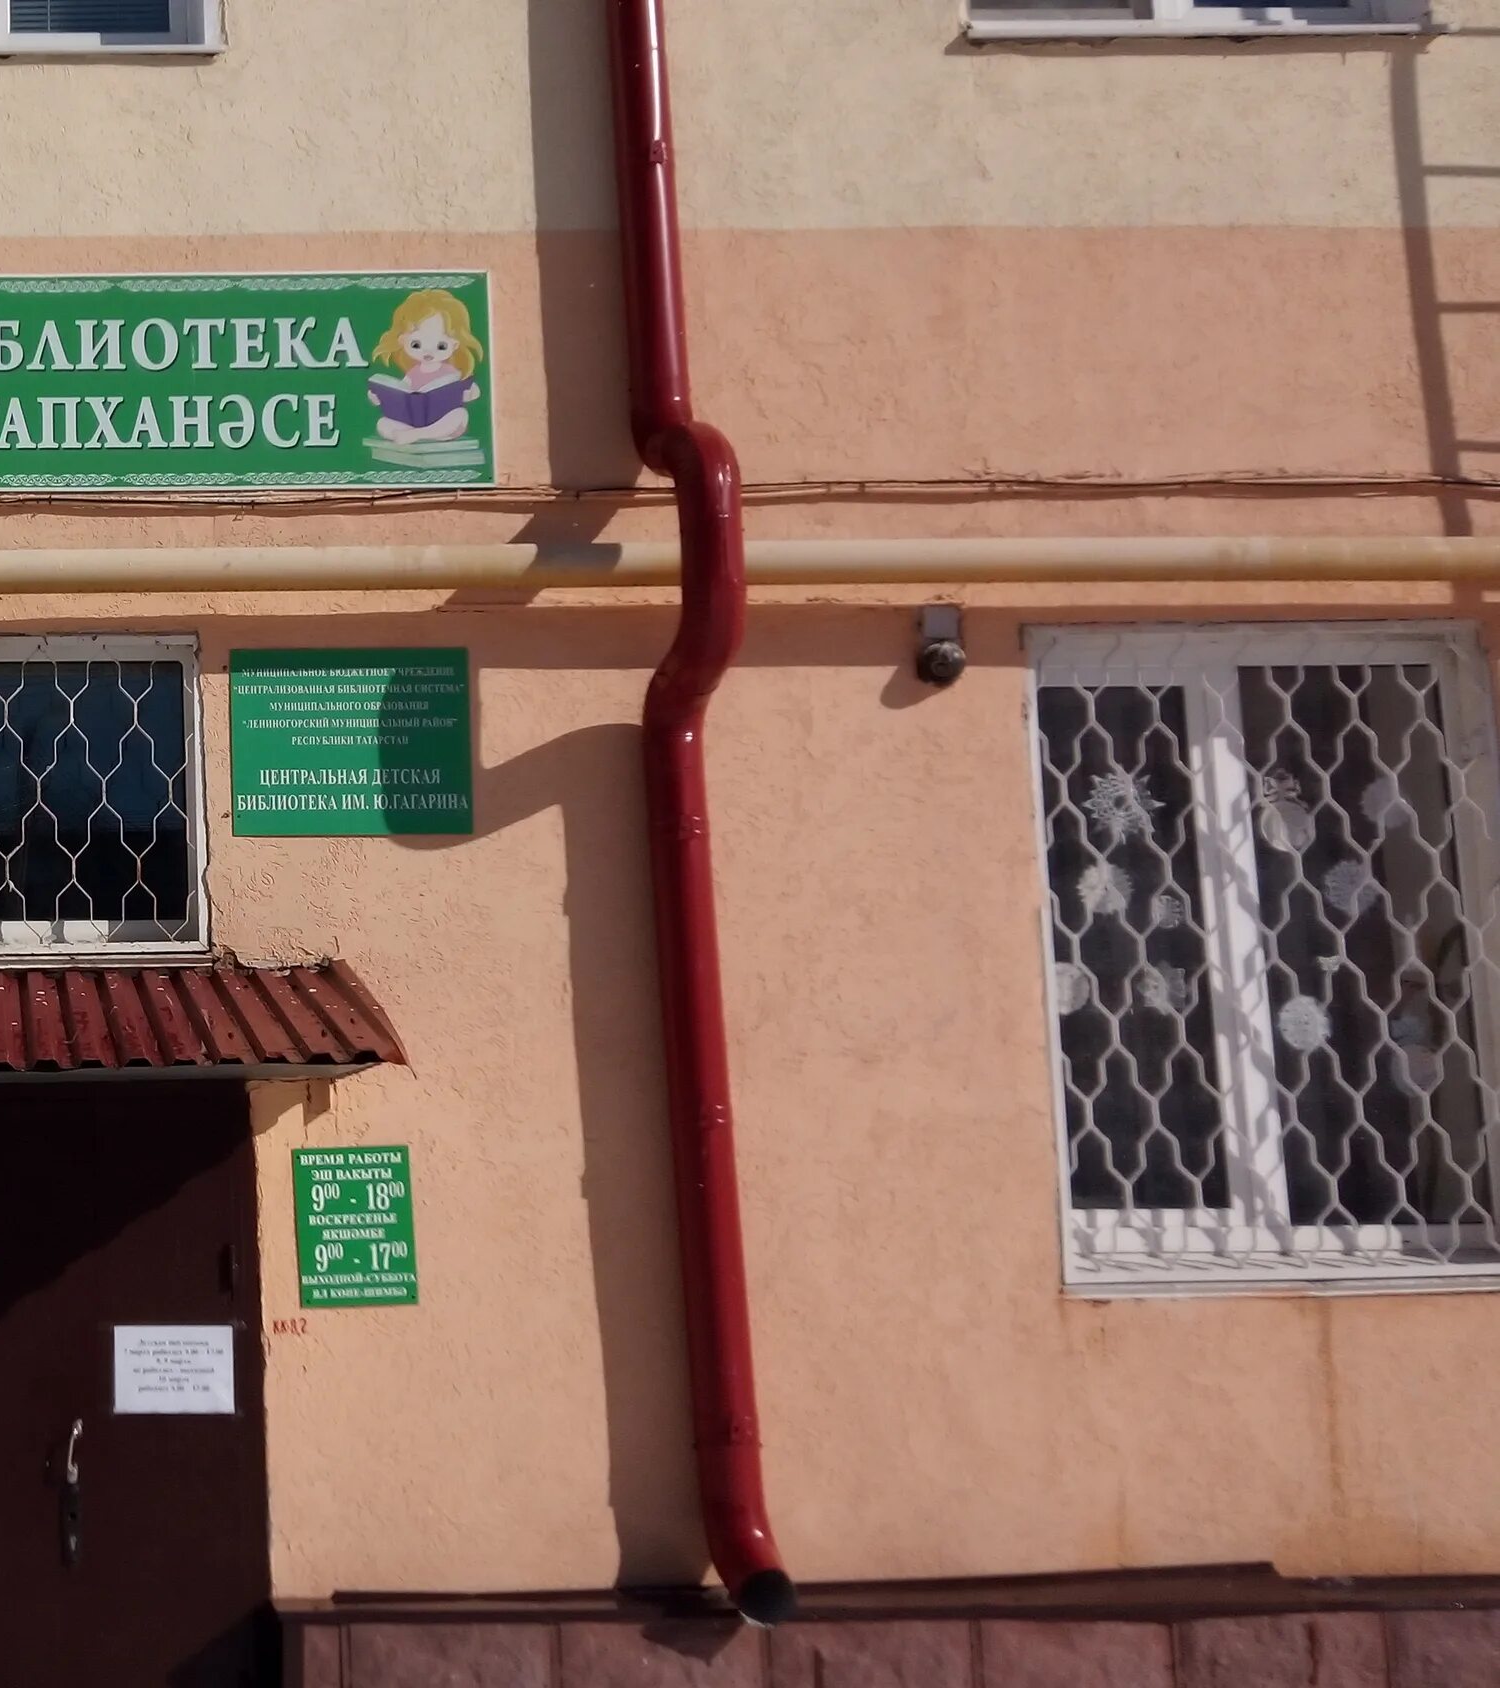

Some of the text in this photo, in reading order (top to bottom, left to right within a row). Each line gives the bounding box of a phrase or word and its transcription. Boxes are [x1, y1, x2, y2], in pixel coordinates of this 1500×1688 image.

[242, 668, 328, 678] МУНИЦИПАЛЬНОЕ
[329, 668, 389, 677] БЮДЖЕТНОЕ
[337, 684, 413, 694] БИБЛИОТЕЧНАЯ
[269, 701, 429, 712] МУНИЦИПАЛЬНОГО ОБРАЗОВАНИЯ
[331, 718, 420, 728] МУНИЦИПАЛЬНЫЙ
[291, 735, 409, 746] РЕСПУБЛИКИ ТАТАРСТАН
[259, 768, 441, 788] ЦЕНТРАЛЬНАЯ ДЕТСКАЯ
[236, 794, 469, 811] БИБЛИОТЕКА ИМ. Ю.ГАГАРИНА
[300, 1151, 402, 1166] ВРЕМЯ РАБОТЫ
[310, 1167, 393, 1181] ЭШ ВАКЫТЫ
[308, 1212, 398, 1226] ВОСКРЕСЕНЬЕ
